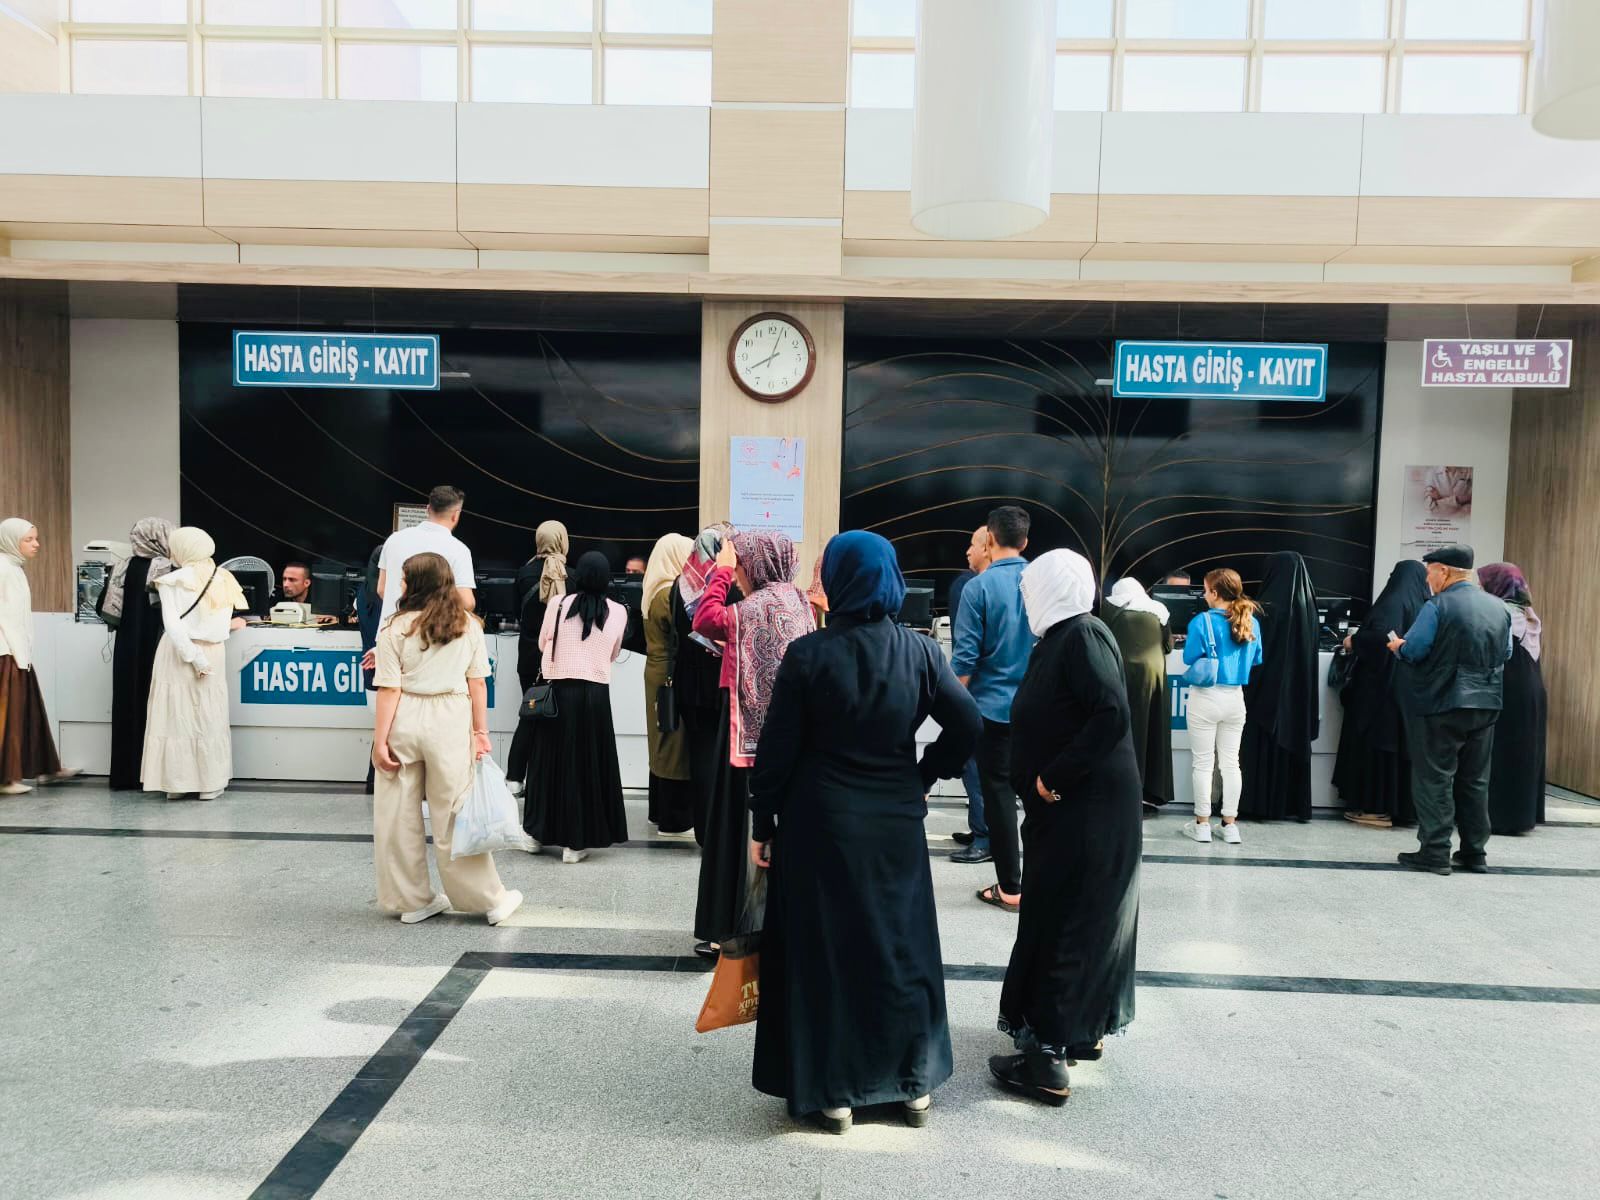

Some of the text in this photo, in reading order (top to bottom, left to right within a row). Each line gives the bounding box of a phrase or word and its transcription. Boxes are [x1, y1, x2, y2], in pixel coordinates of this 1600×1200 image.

[755, 329, 763, 338] 11
[768, 326, 777, 335] 12
[745, 339, 754, 348] 10
[791, 340, 799, 349] 2
[1459, 344, 1536, 357] YAŞLI VE
[244, 344, 304, 373] HASTA
[309, 339, 359, 381] GİRİŞ
[374, 347, 429, 376] KAYIT
[1463, 358, 1530, 370] ENGELLİ
[1125, 354, 1187, 383] HASTA
[1192, 349, 1244, 392] GİRİŞ
[1259, 357, 1316, 386] KAYIT
[1431, 371, 1561, 383] HASTA KABULÜ
[253, 661, 327, 692] HASTA
